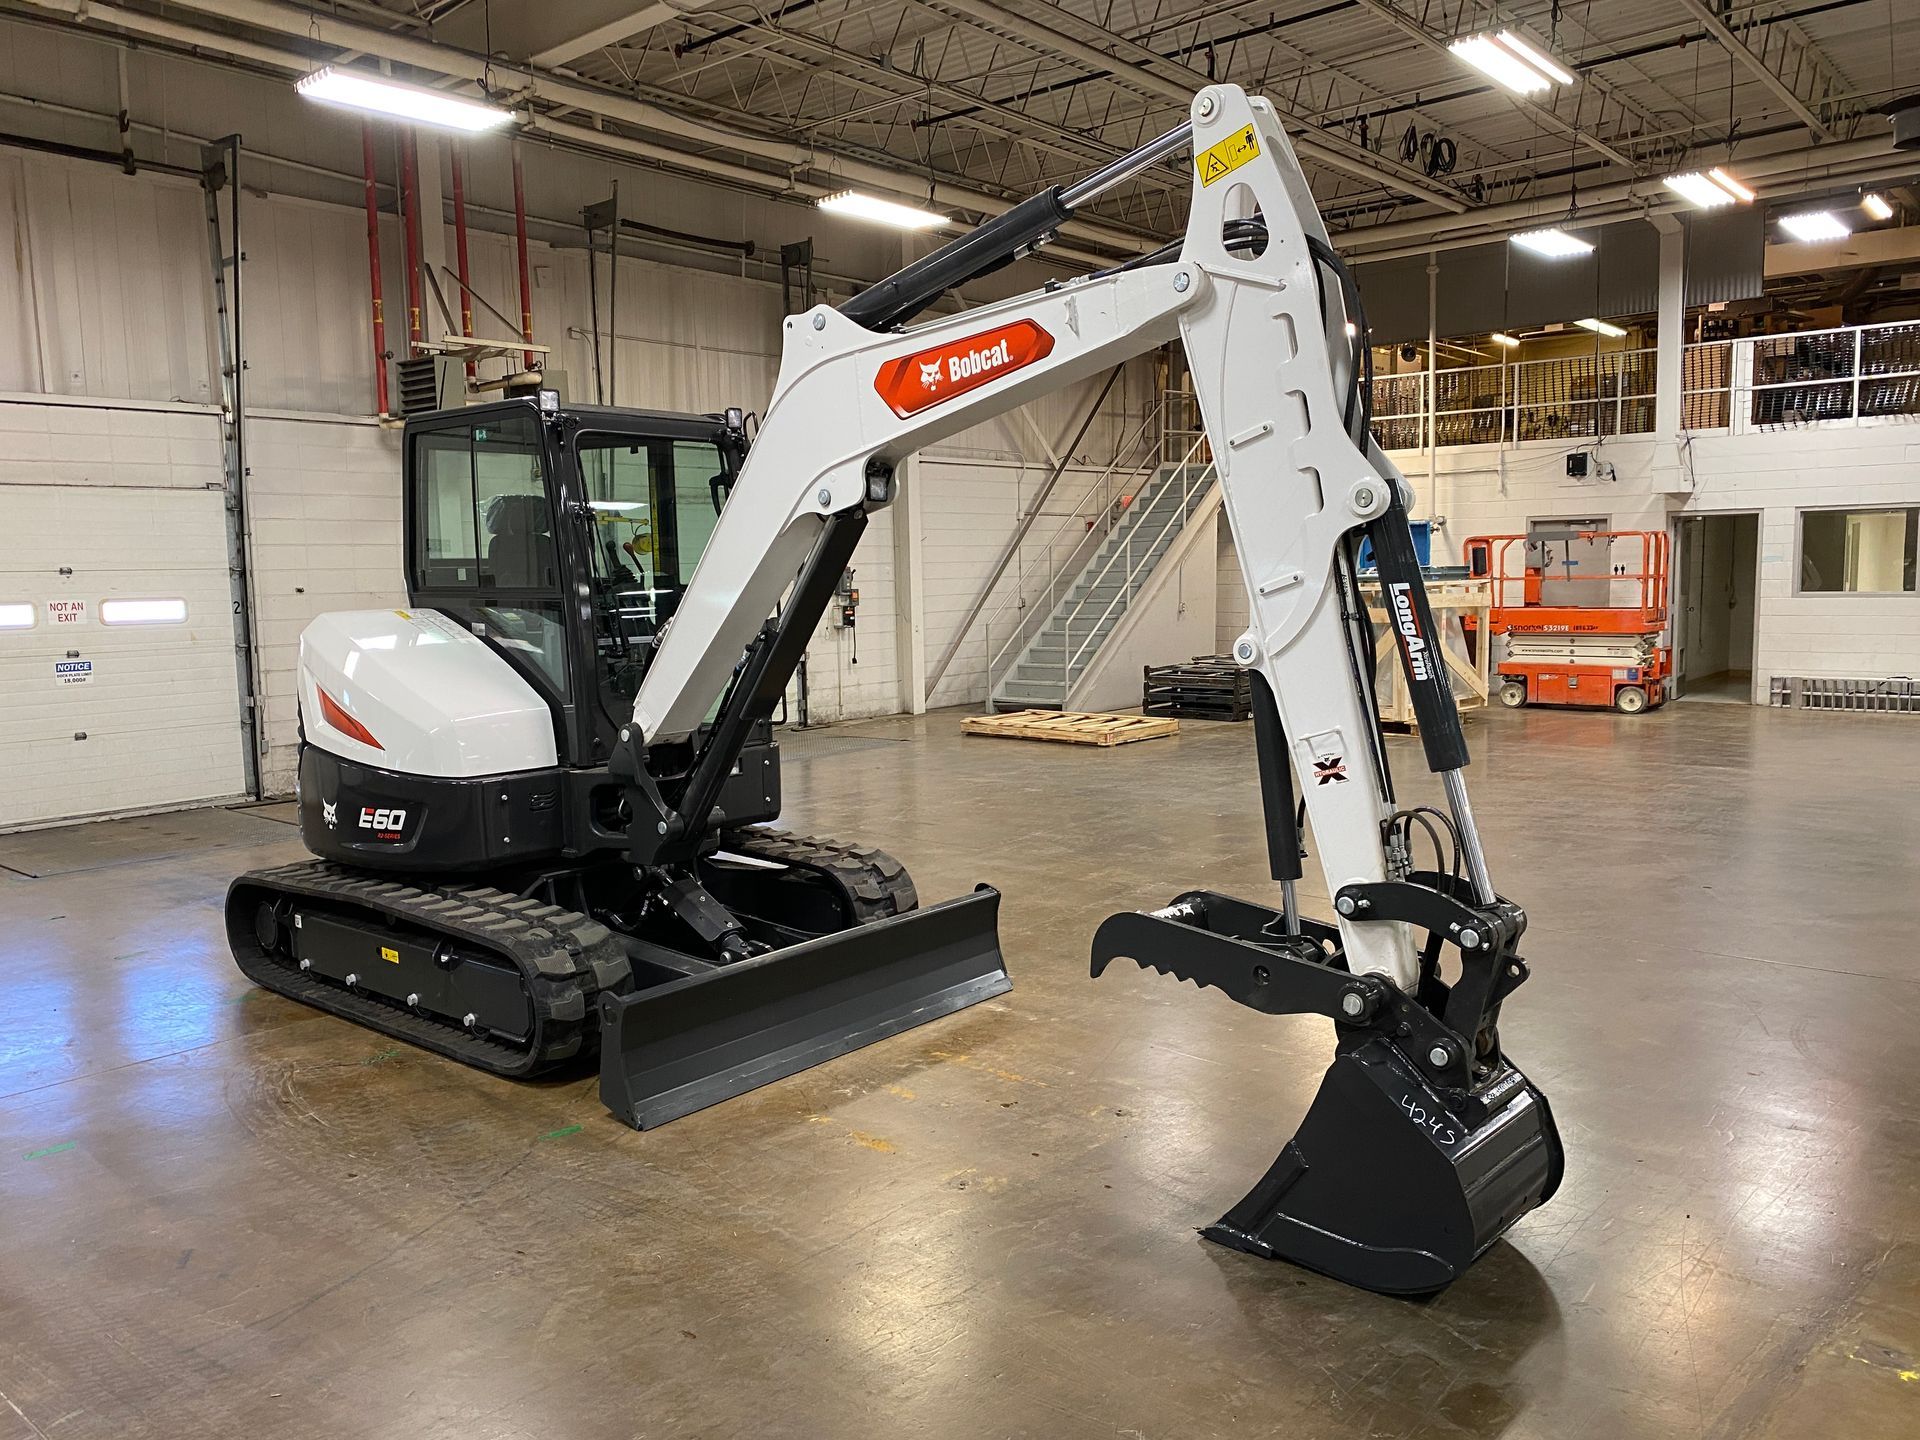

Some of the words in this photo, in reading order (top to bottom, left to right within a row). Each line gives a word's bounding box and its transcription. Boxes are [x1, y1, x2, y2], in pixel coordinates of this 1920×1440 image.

[948, 338, 1010, 382] Bobcat
[49, 602, 69, 612] NOT
[71, 602, 84, 611] AN
[233, 600, 241, 615] 2
[57, 613, 77, 623] EXIT
[1389, 583, 1428, 681] LongArm
[56, 662, 90, 672] NOTICE
[358, 807, 407, 831] E60
